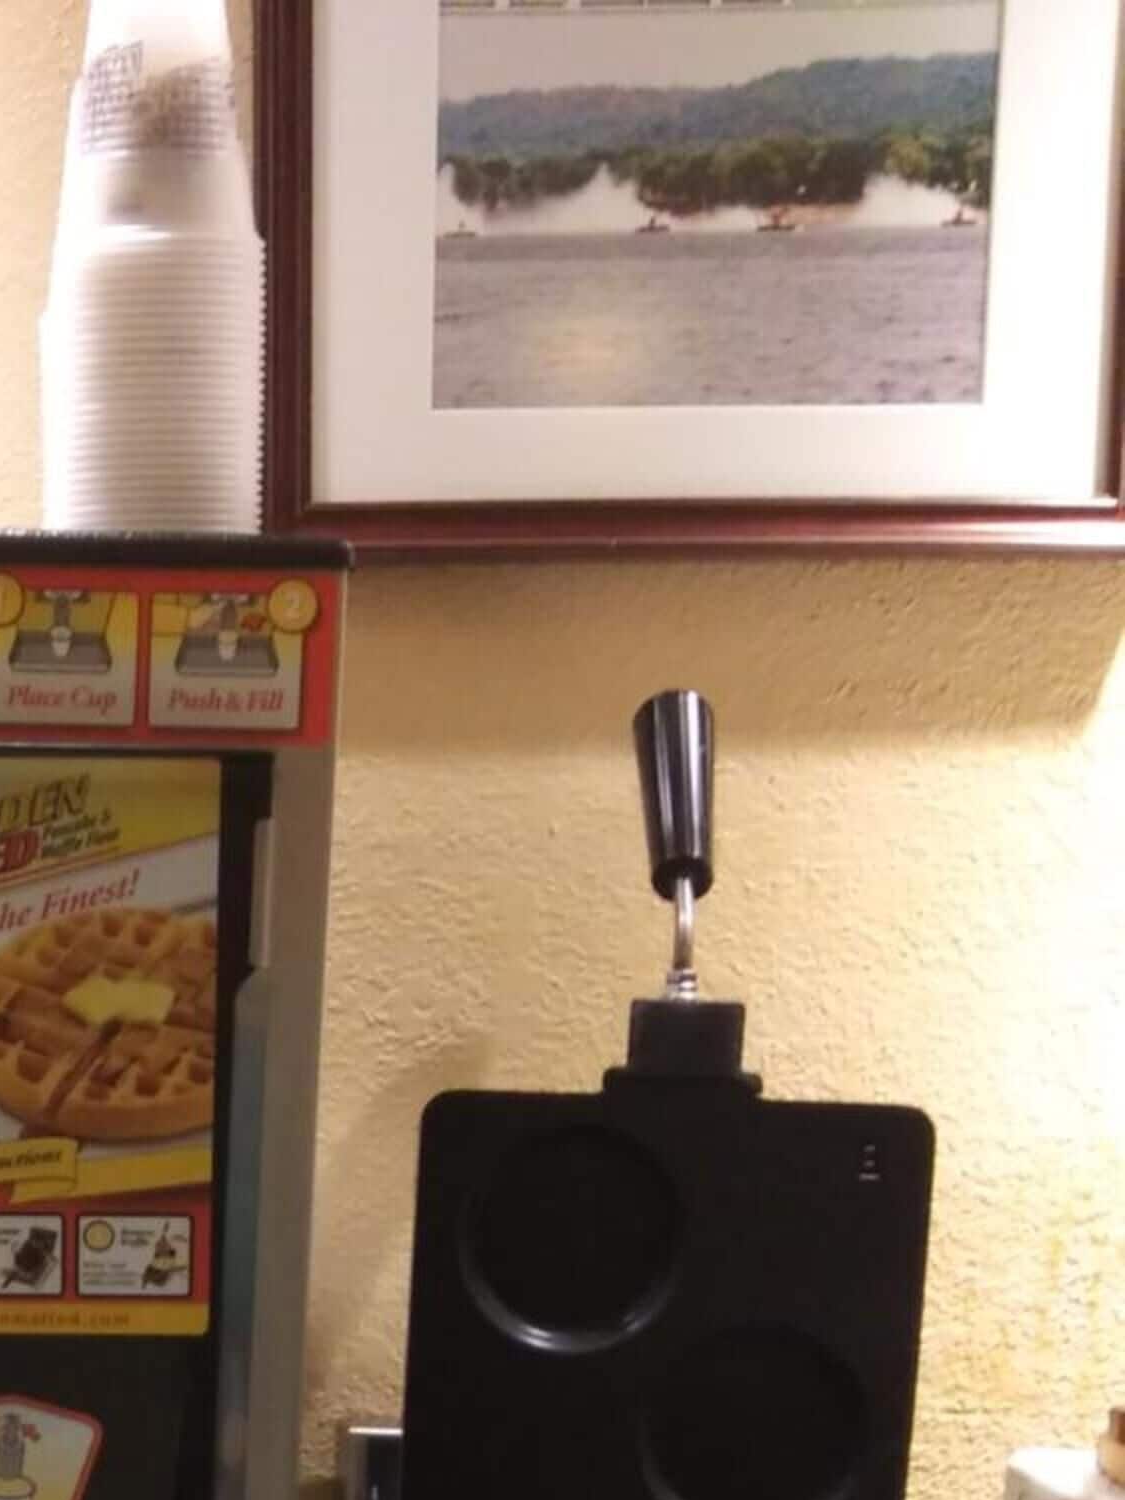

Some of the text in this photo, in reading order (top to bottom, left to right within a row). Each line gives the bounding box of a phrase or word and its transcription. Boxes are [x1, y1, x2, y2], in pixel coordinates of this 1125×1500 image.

[6, 685, 118, 715] Place Cup
[167, 688, 220, 711] Push
[246, 688, 285, 712] Fill
[41, 867, 141, 919] Finest!
